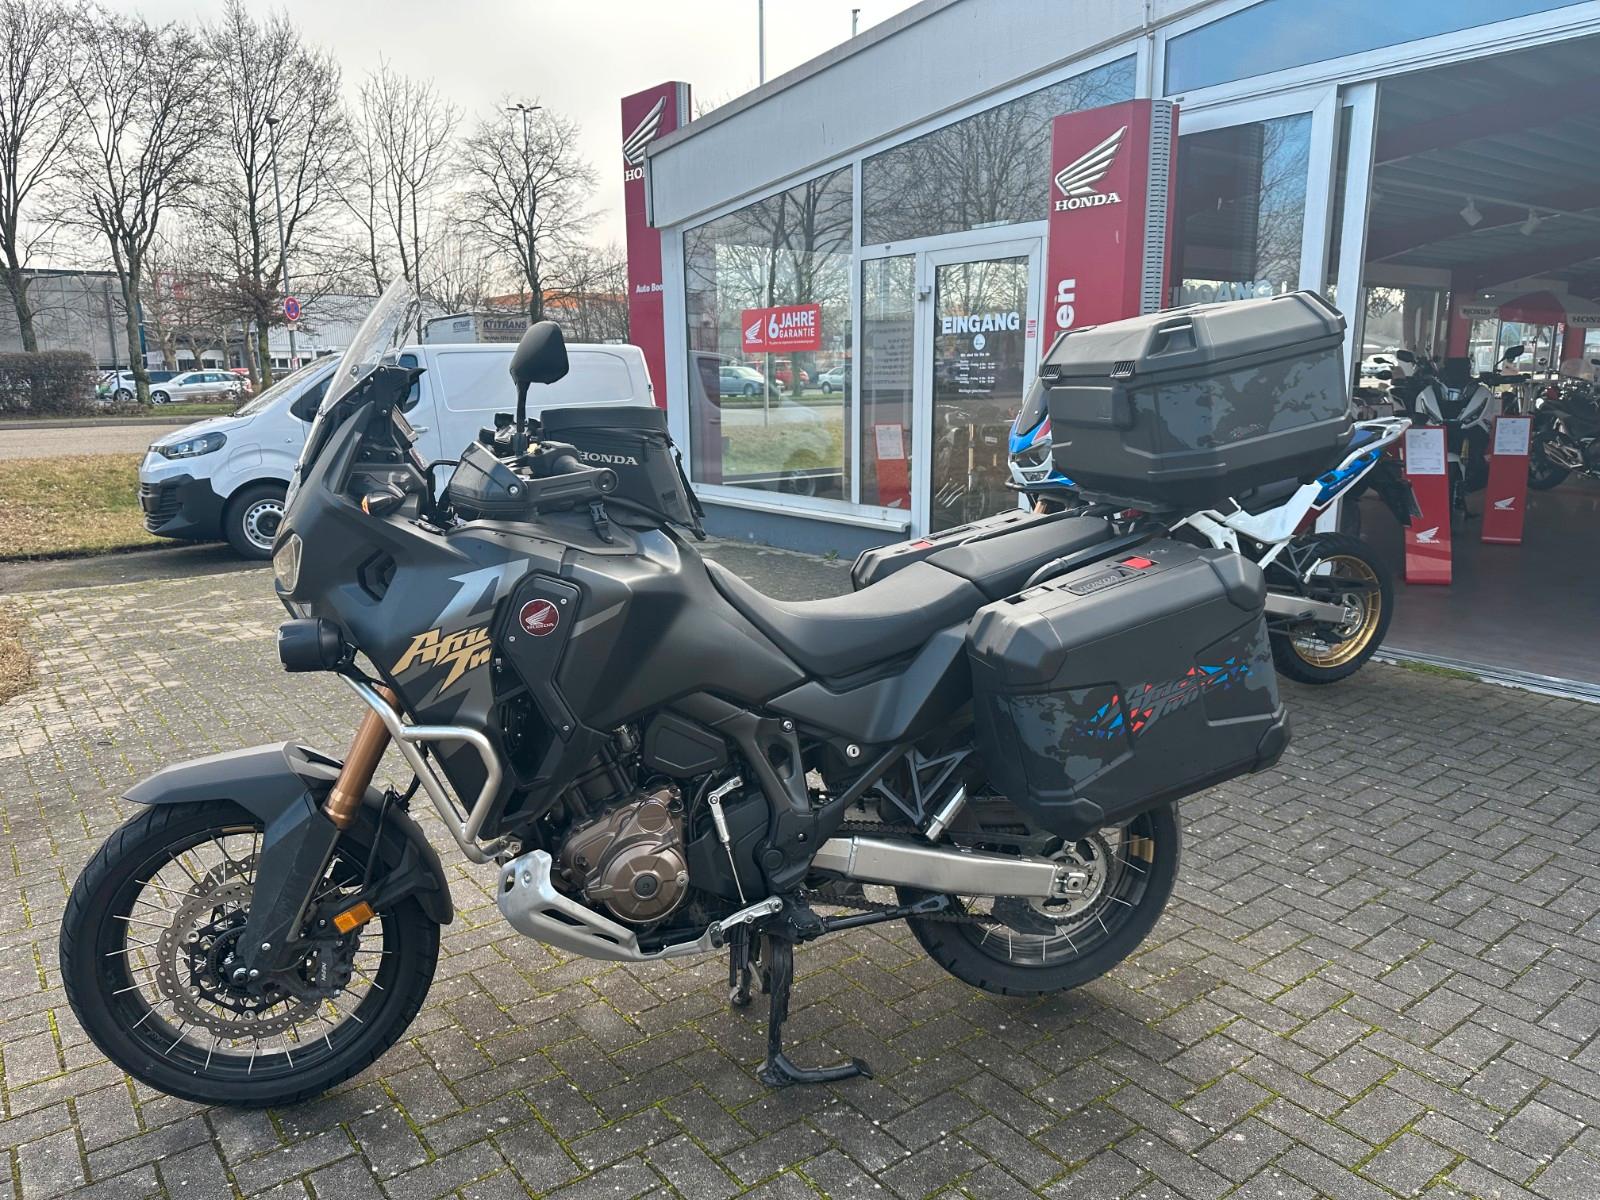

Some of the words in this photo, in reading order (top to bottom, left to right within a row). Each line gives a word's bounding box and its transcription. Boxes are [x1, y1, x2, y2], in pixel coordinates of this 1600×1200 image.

[625, 167, 645, 182] HO
[1055, 192, 1122, 212] HONDA
[636, 284, 650, 294] Auto
[768, 314, 779, 339] 6
[780, 311, 816, 328] JAHRE
[942, 312, 1020, 335] EINGANG
[779, 328, 816, 338] GARANTIE
